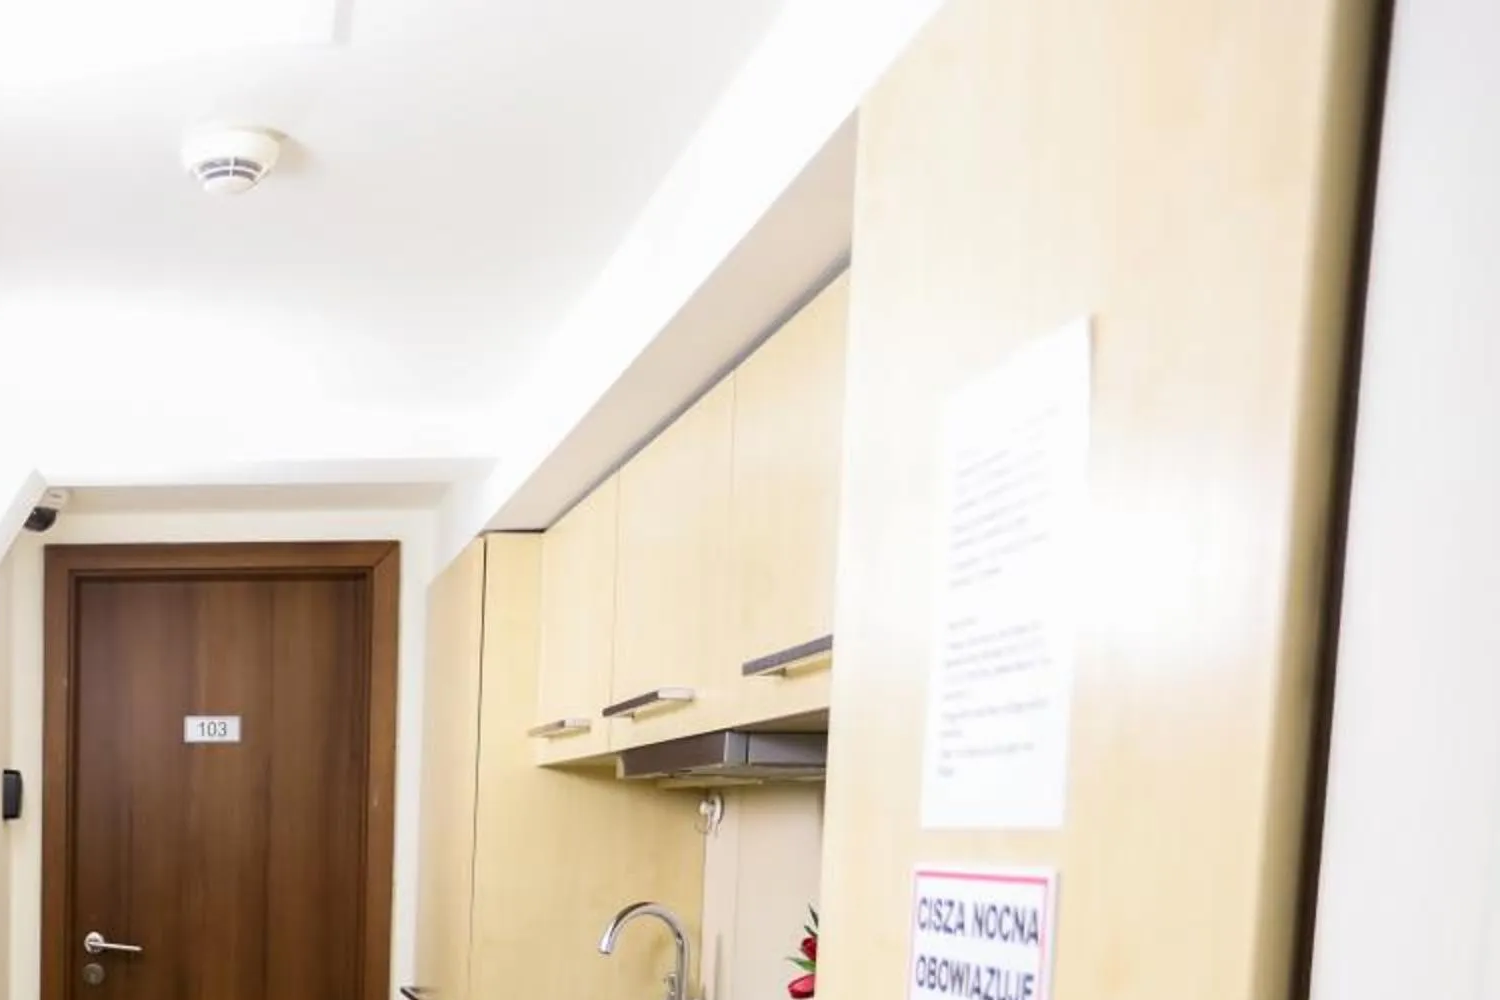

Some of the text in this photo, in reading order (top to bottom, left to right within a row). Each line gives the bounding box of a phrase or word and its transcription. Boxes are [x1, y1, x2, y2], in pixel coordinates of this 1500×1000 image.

[196, 721, 227, 737] 103
[917, 897, 1039, 945] CISZA NOCNA
